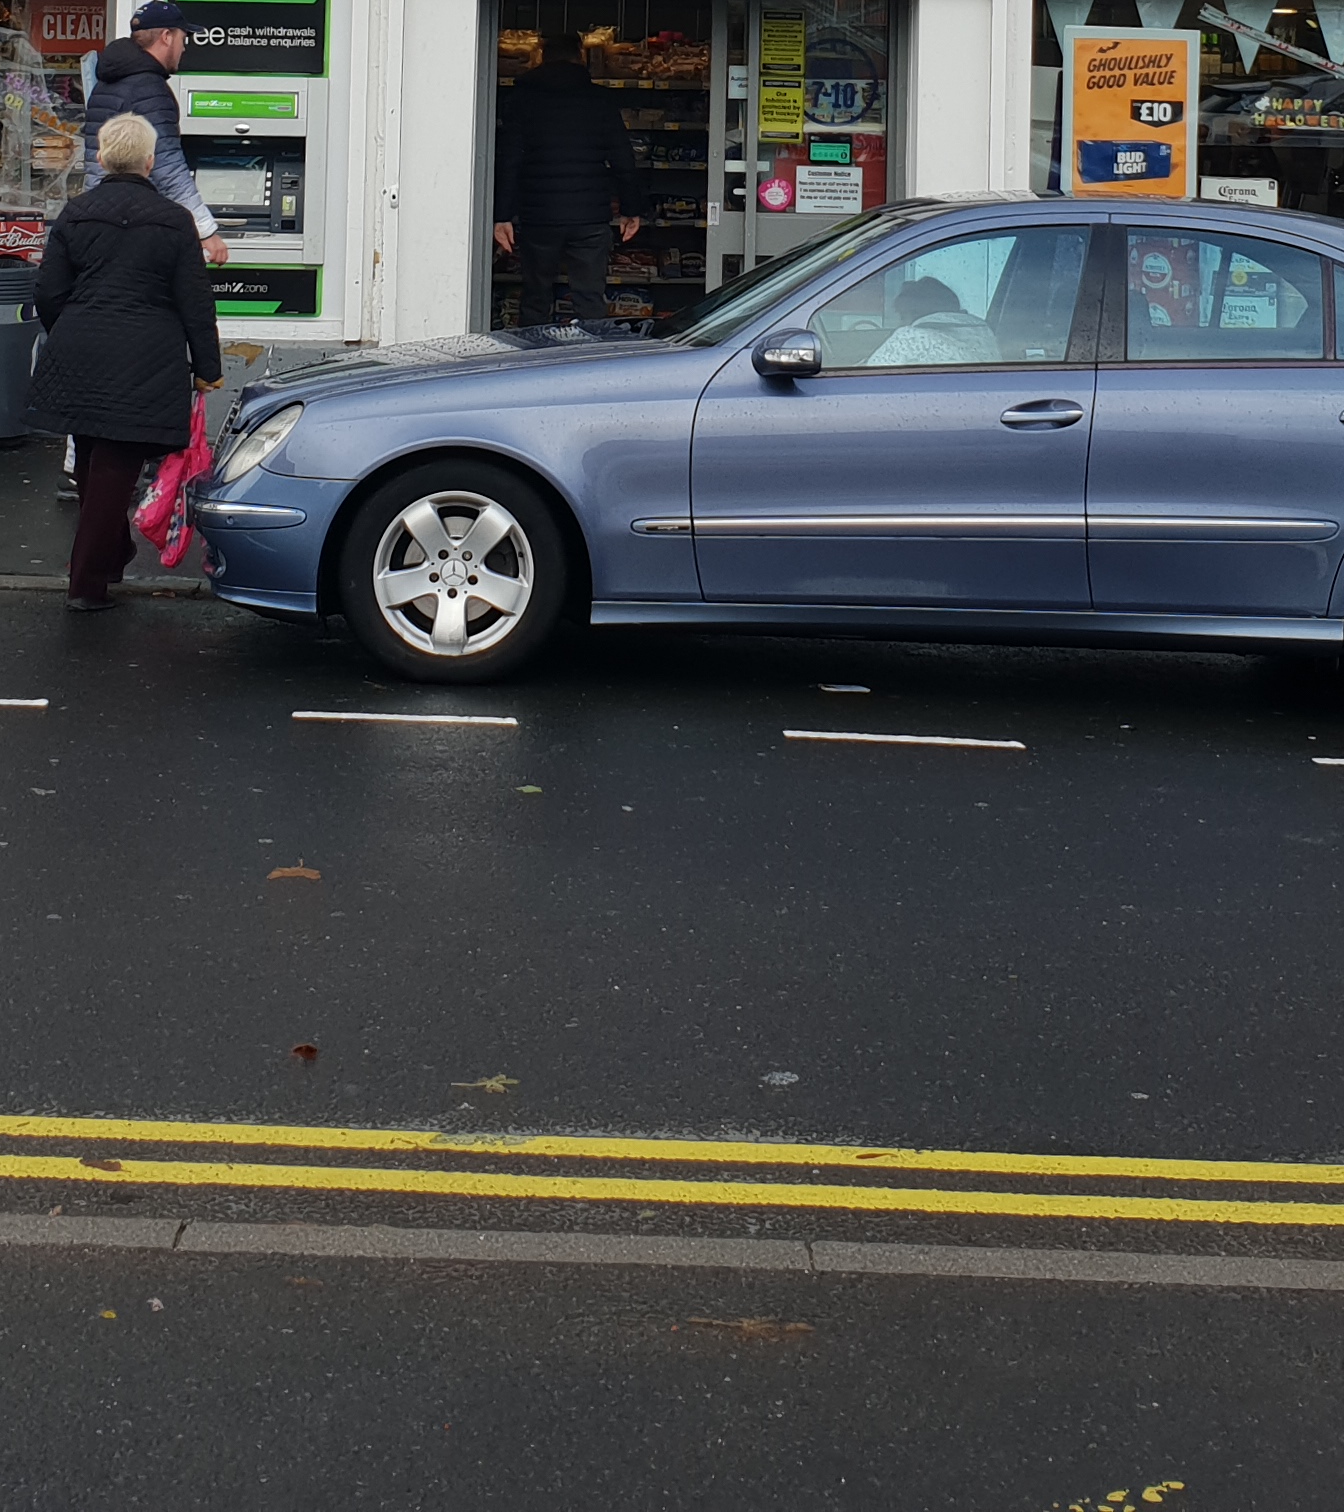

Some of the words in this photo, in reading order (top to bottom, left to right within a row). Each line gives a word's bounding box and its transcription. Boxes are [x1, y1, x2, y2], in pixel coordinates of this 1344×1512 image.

[42, 14, 104, 40] CLEAR
[185, 26, 225, 46] ee
[227, 26, 253, 36] cash
[255, 26, 316, 37] withdrawals
[227, 37, 268, 46] balance
[270, 38, 316, 48] enquiries
[1087, 53, 1174, 73] GHOULISHLY
[1086, 73, 1127, 90] GOOD
[1133, 70, 1177, 87] VALUE
[1139, 102, 1172, 122] £10
[1271, 97, 1324, 113] HAPPY
[1117, 151, 1145, 163] BUD
[1113, 161, 1147, 174] LIGHT
[1218, 185, 1259, 198] Corona
[211, 282, 232, 293] ash
